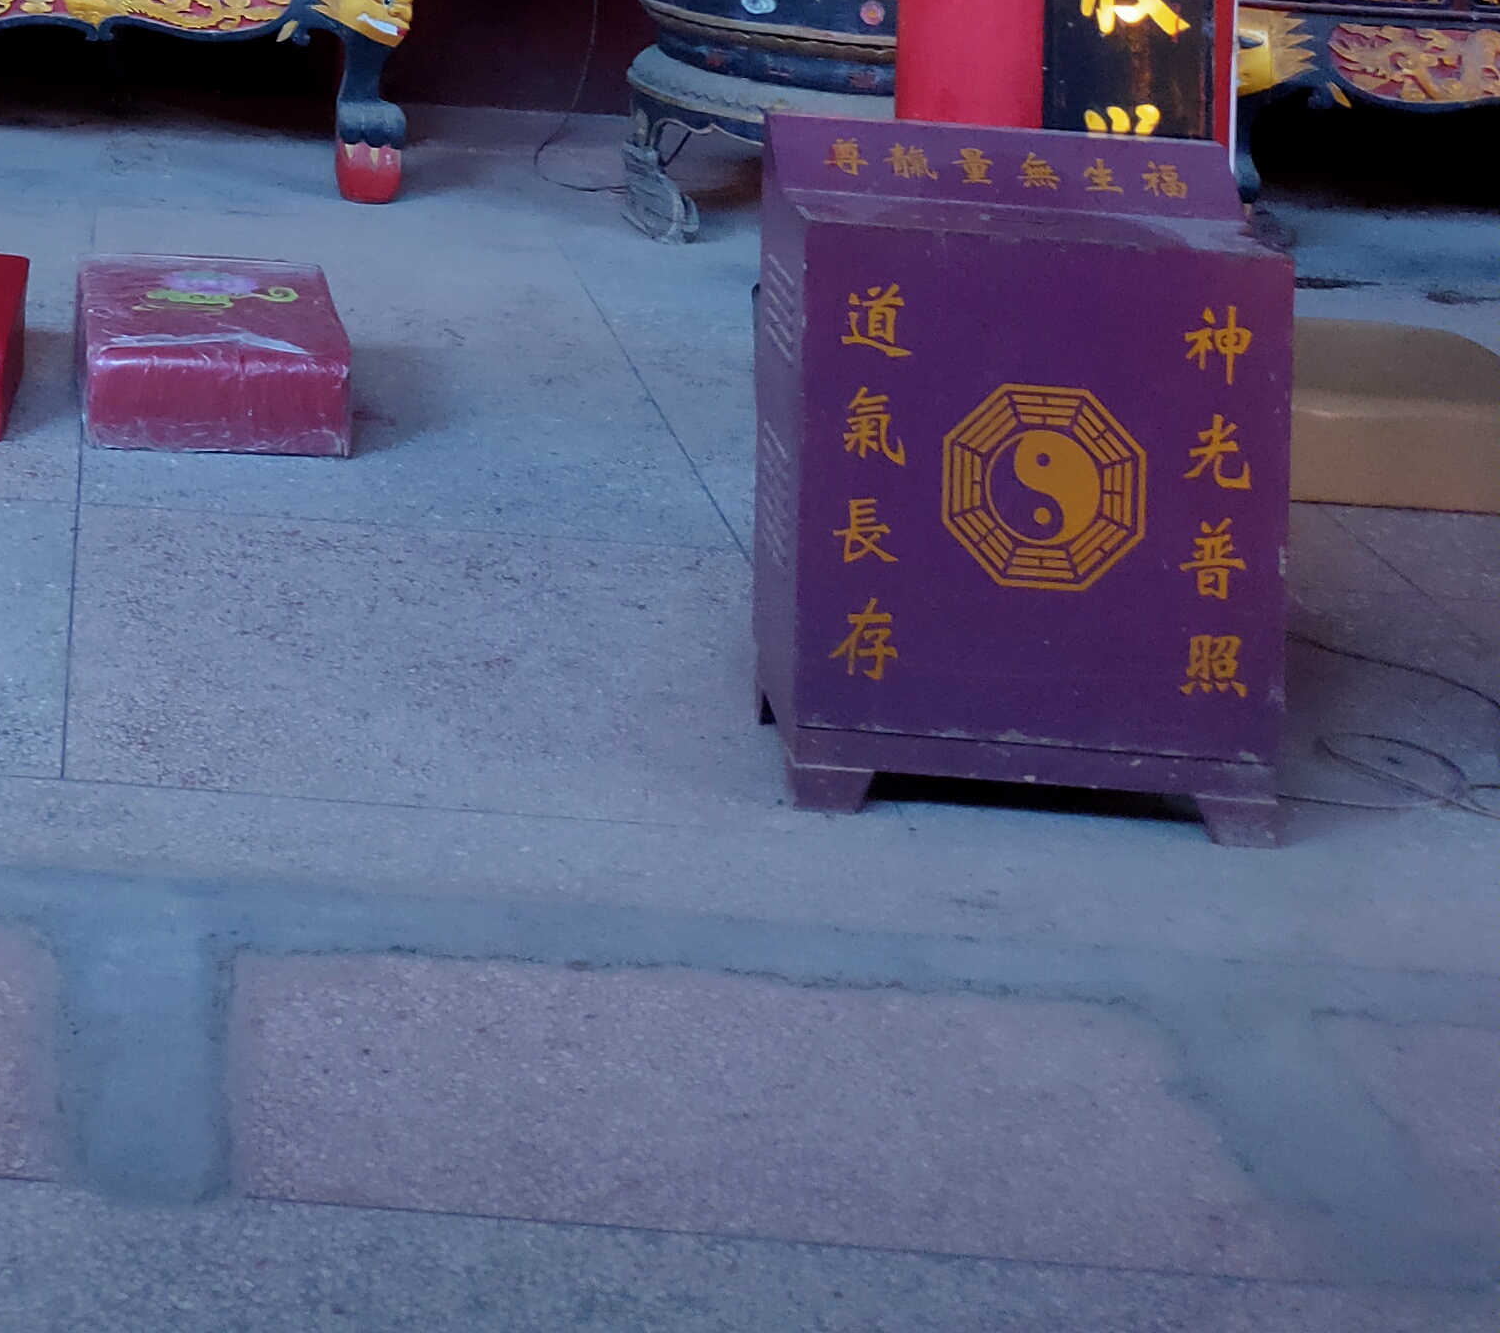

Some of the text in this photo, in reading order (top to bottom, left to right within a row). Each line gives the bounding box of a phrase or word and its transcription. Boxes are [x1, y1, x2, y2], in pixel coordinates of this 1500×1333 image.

[829, 283, 912, 681] 道氣長存
[1180, 306, 1253, 698] 神光普照
